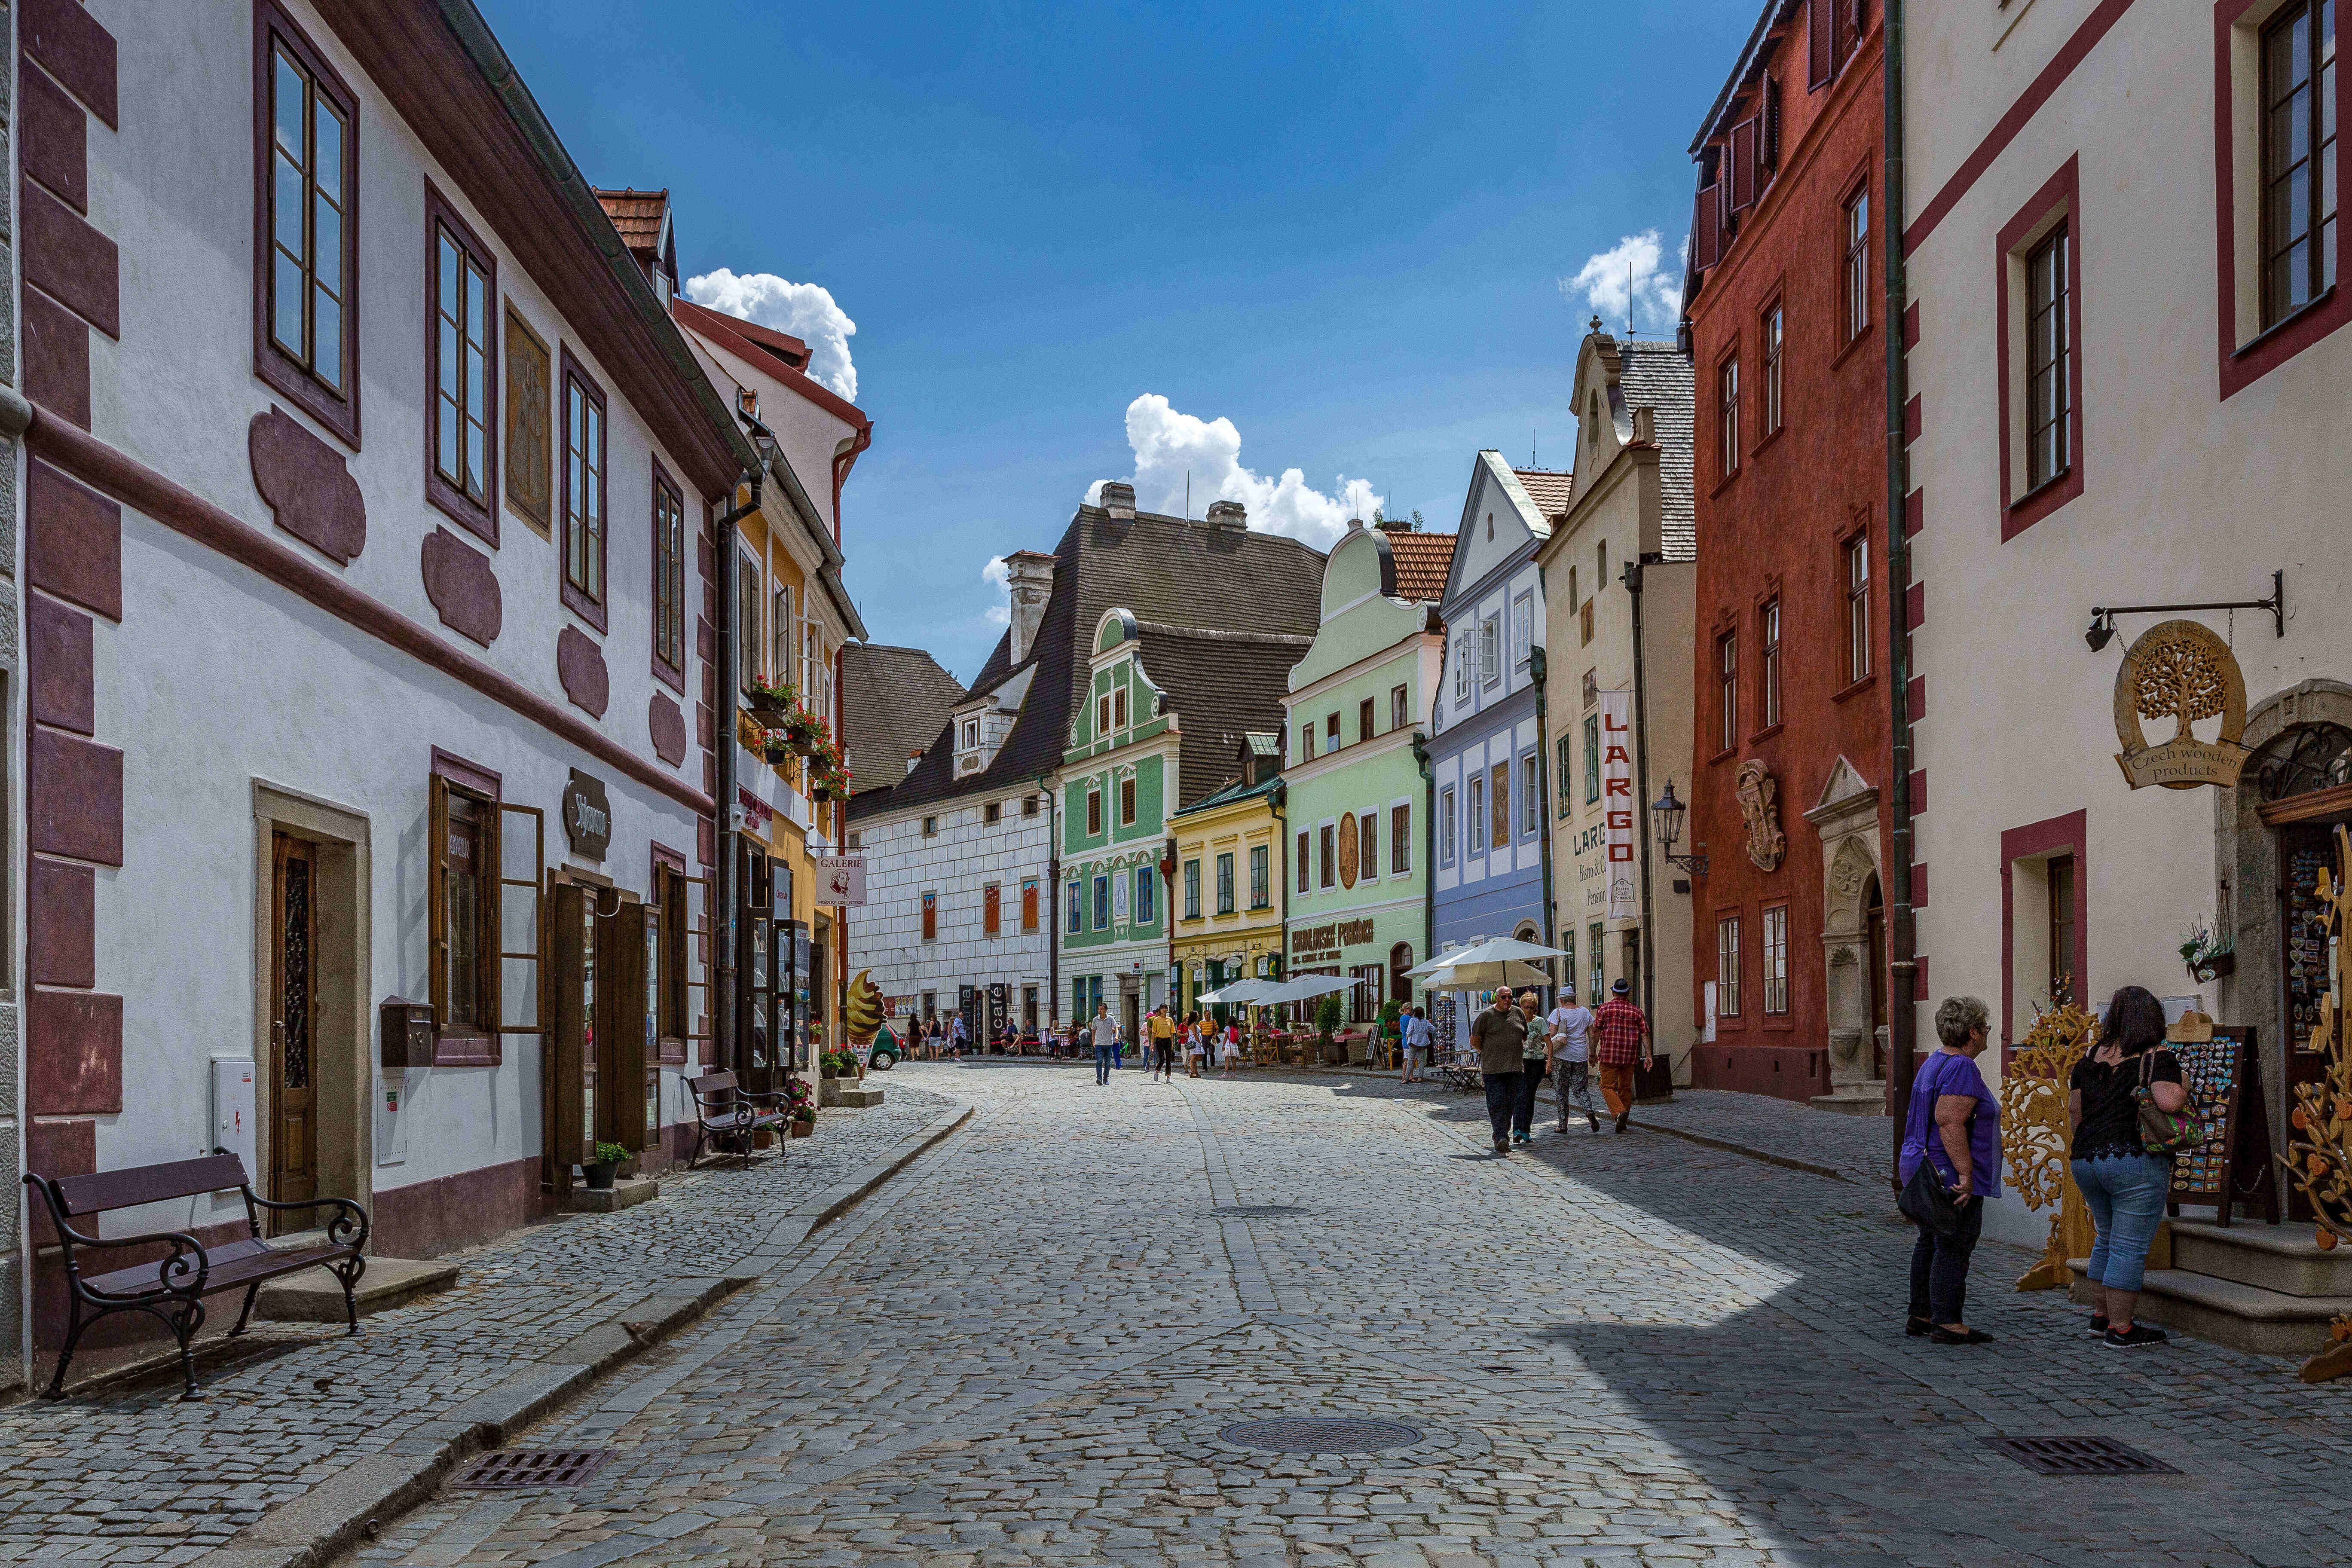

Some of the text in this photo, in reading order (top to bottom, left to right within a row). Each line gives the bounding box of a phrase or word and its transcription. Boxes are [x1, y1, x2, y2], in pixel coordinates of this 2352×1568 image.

[2132, 747, 2237, 770] Czech wooden
[2153, 763, 2218, 781] products
[1604, 713, 1633, 862] LARGO
[1574, 821, 1606, 856] LARG
[820, 859, 863, 868] GALERIE
[1579, 863, 1593, 882] Bistro
[1587, 886, 1606, 906] Pension
[991, 987, 1002, 1029] café
